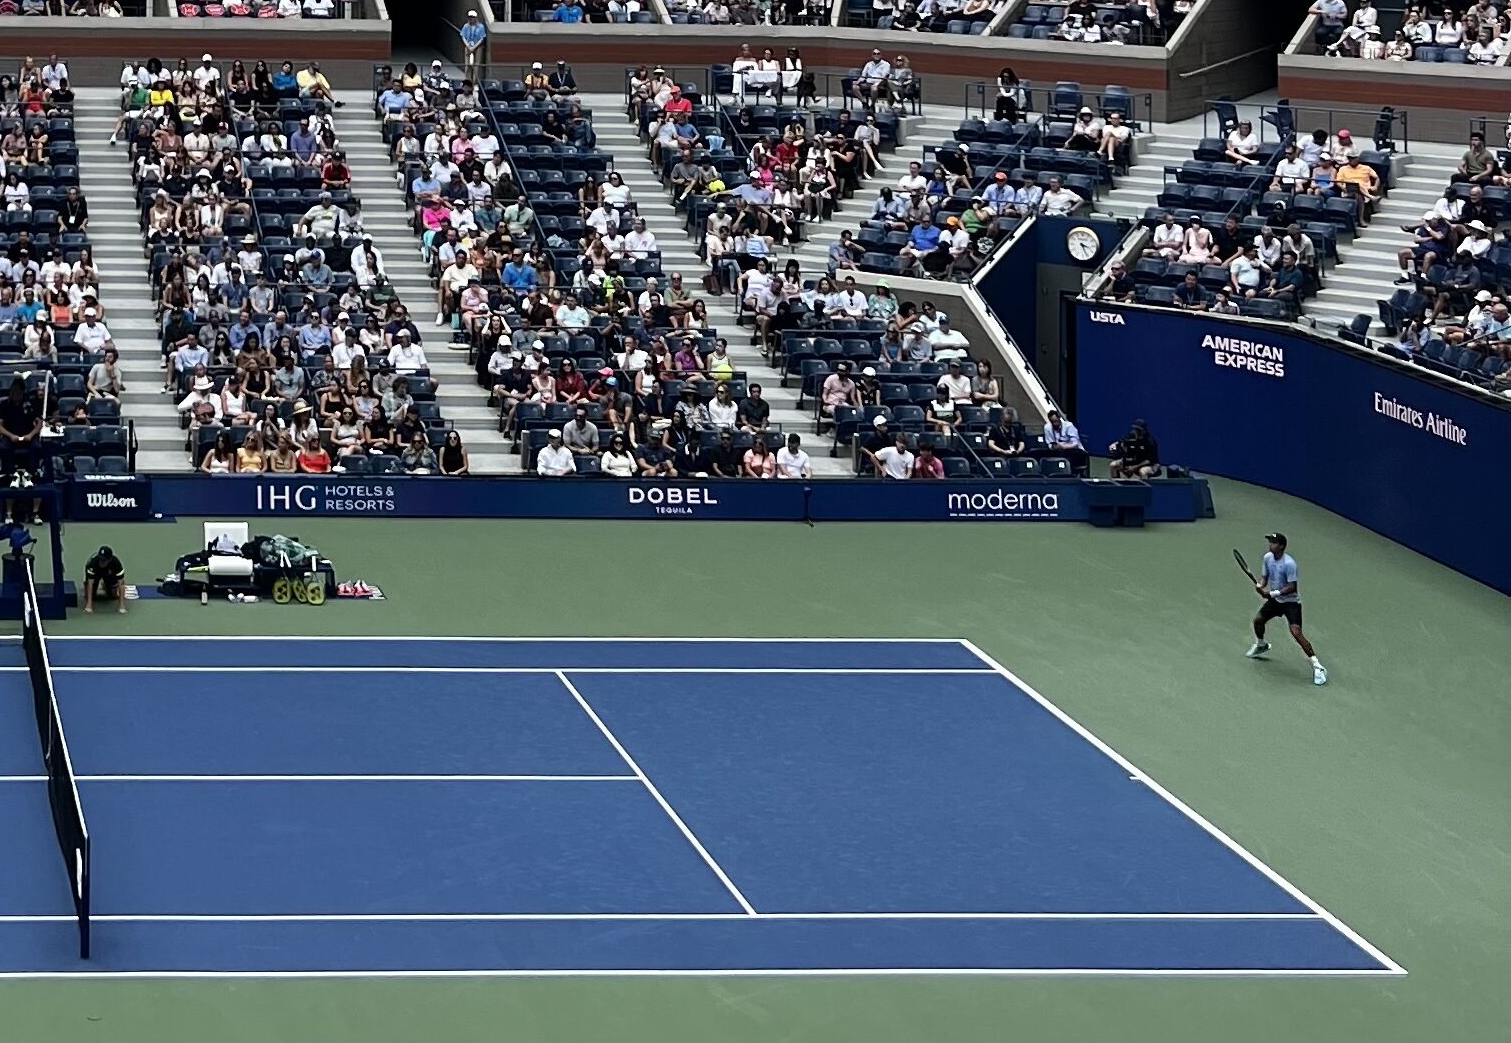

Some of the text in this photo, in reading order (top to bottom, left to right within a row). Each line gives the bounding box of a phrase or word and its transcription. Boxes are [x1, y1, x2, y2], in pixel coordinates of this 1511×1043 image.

[1090, 311, 1125, 325] USTA
[1201, 334, 1283, 361] AMERICAN
[1214, 352, 1284, 377] EXPRESS
[1374, 391, 1467, 446] Emirates Airline
[86, 493, 136, 507] Wilson
[256, 485, 394, 511] IHG HOTELS &
[325, 499, 395, 510] RESORTS
[629, 487, 718, 505] DOBEL
[947, 488, 1058, 510] moderna
[655, 506, 693, 514] TEQUILA
